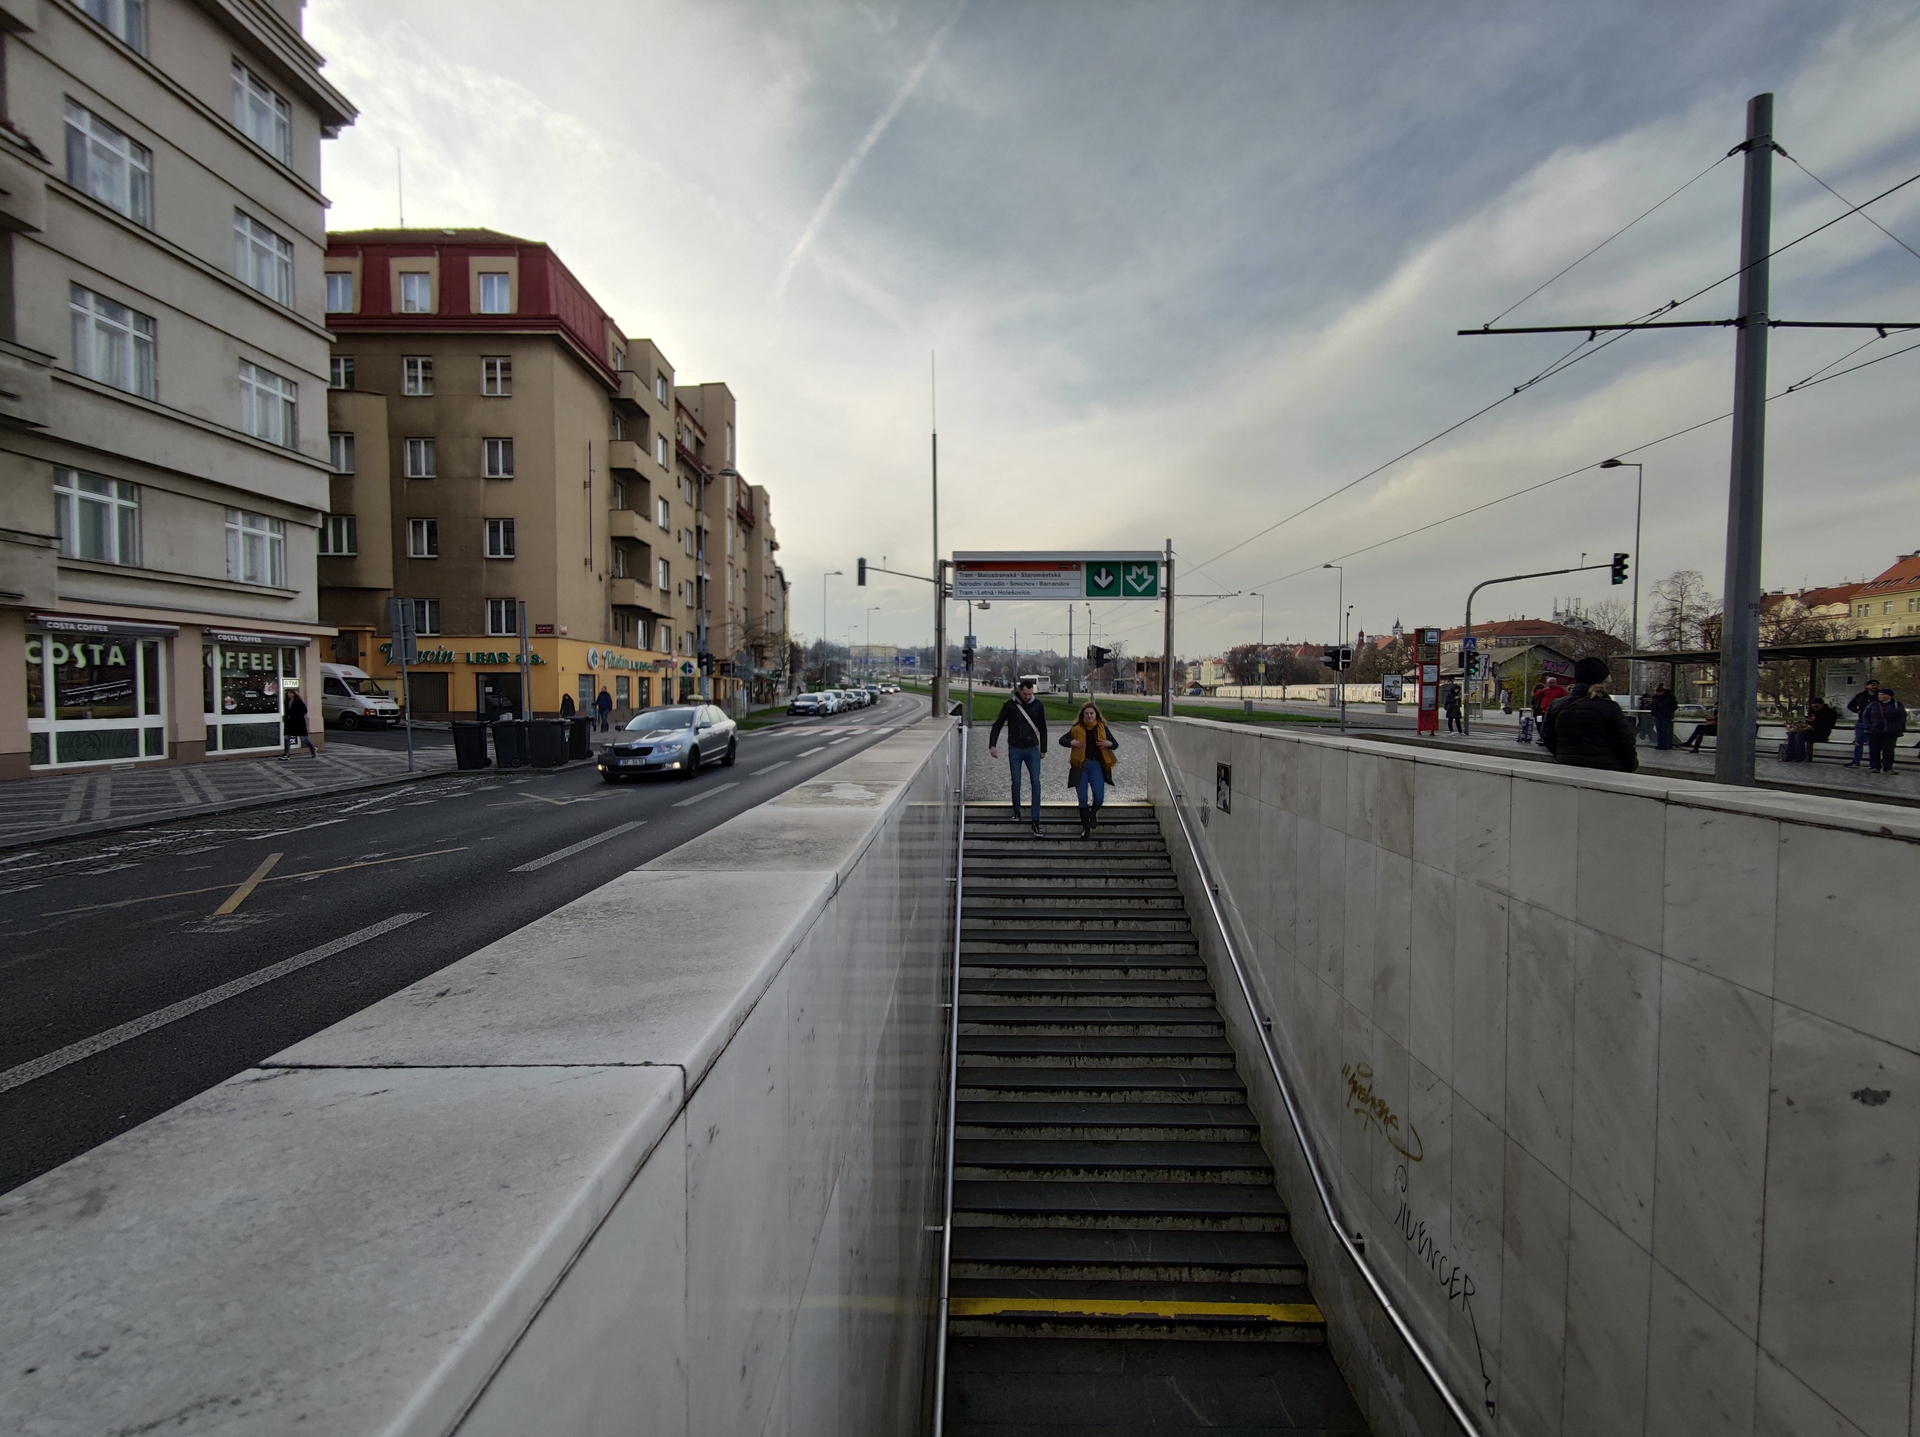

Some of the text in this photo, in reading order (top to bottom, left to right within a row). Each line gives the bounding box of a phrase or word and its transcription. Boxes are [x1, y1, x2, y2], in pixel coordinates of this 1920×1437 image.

[46, 621, 109, 632] COSTA COFFEE
[217, 634, 239, 642] COSTA
[26, 640, 127, 669] COSTA
[465, 651, 511, 665] LEAS
